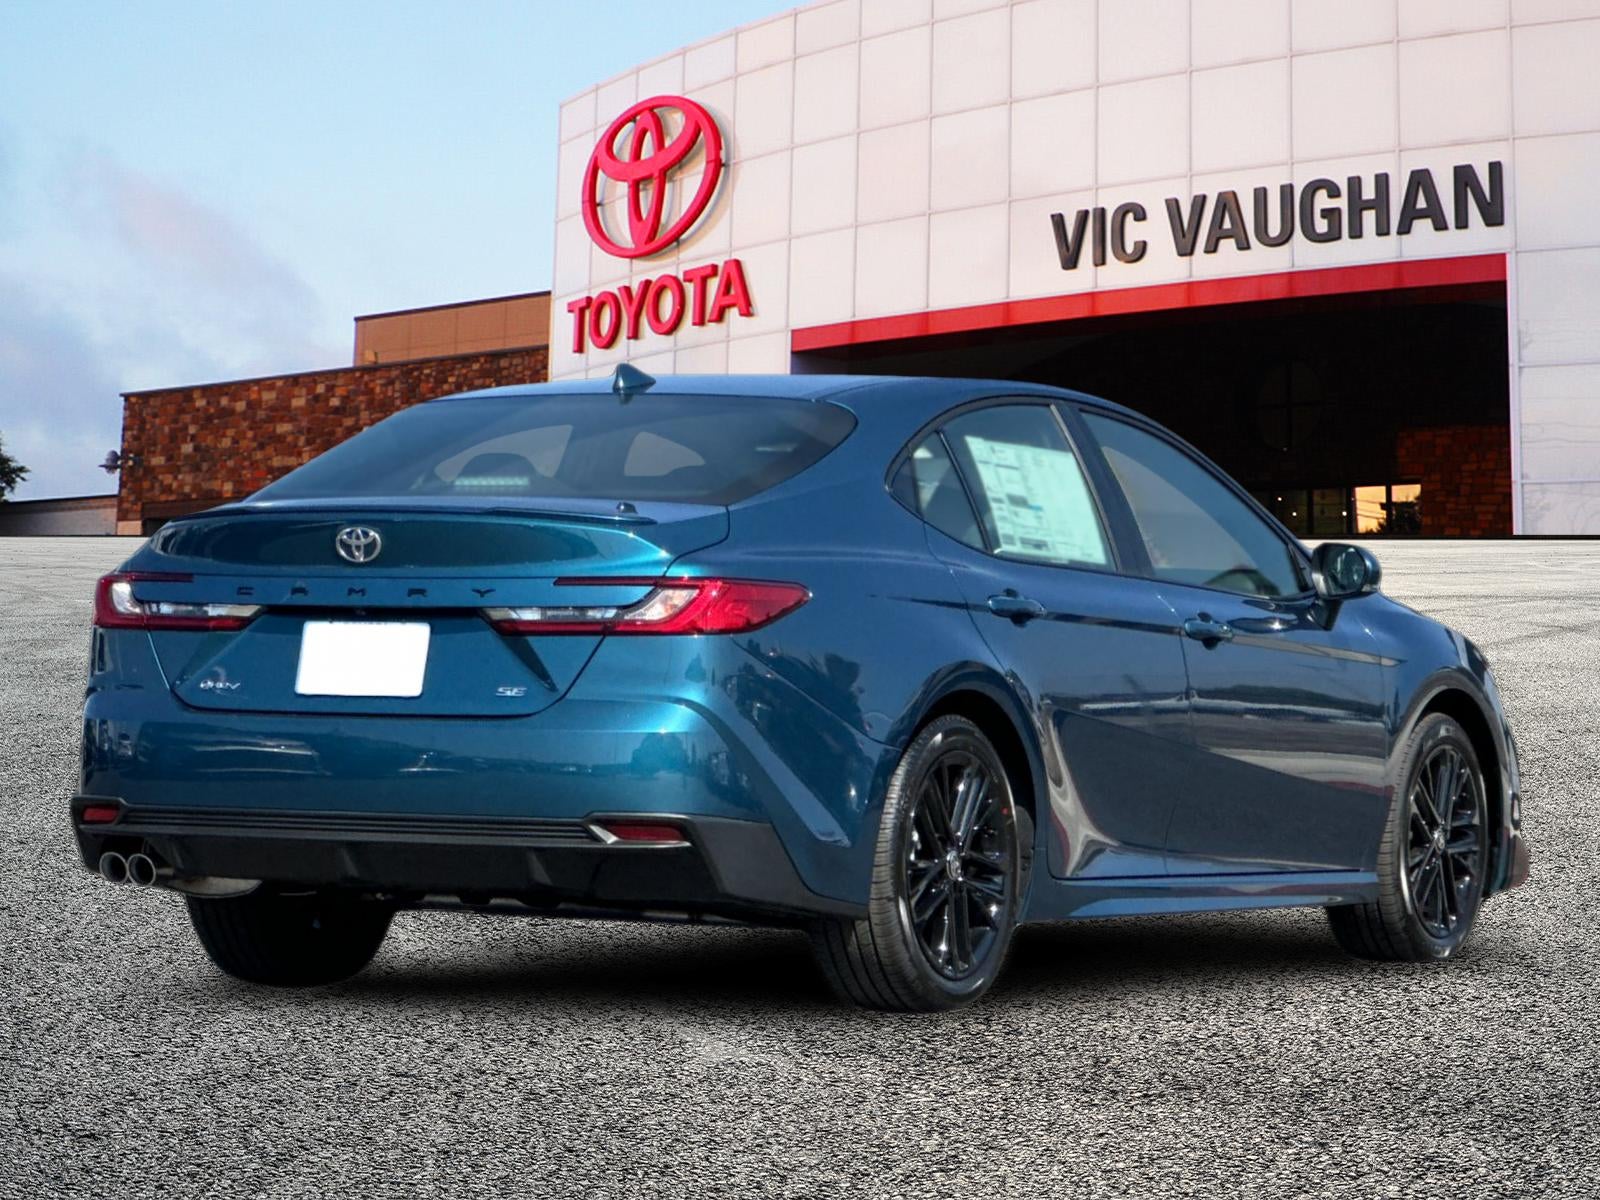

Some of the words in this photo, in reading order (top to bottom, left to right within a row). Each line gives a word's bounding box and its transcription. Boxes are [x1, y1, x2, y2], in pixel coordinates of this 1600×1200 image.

[1050, 201, 1148, 271] VIC
[1164, 160, 1505, 257] VAUGHAN
[567, 258, 754, 354] TOYOTA
[236, 586, 496, 598] CAMRY
[495, 686, 528, 697] SE
